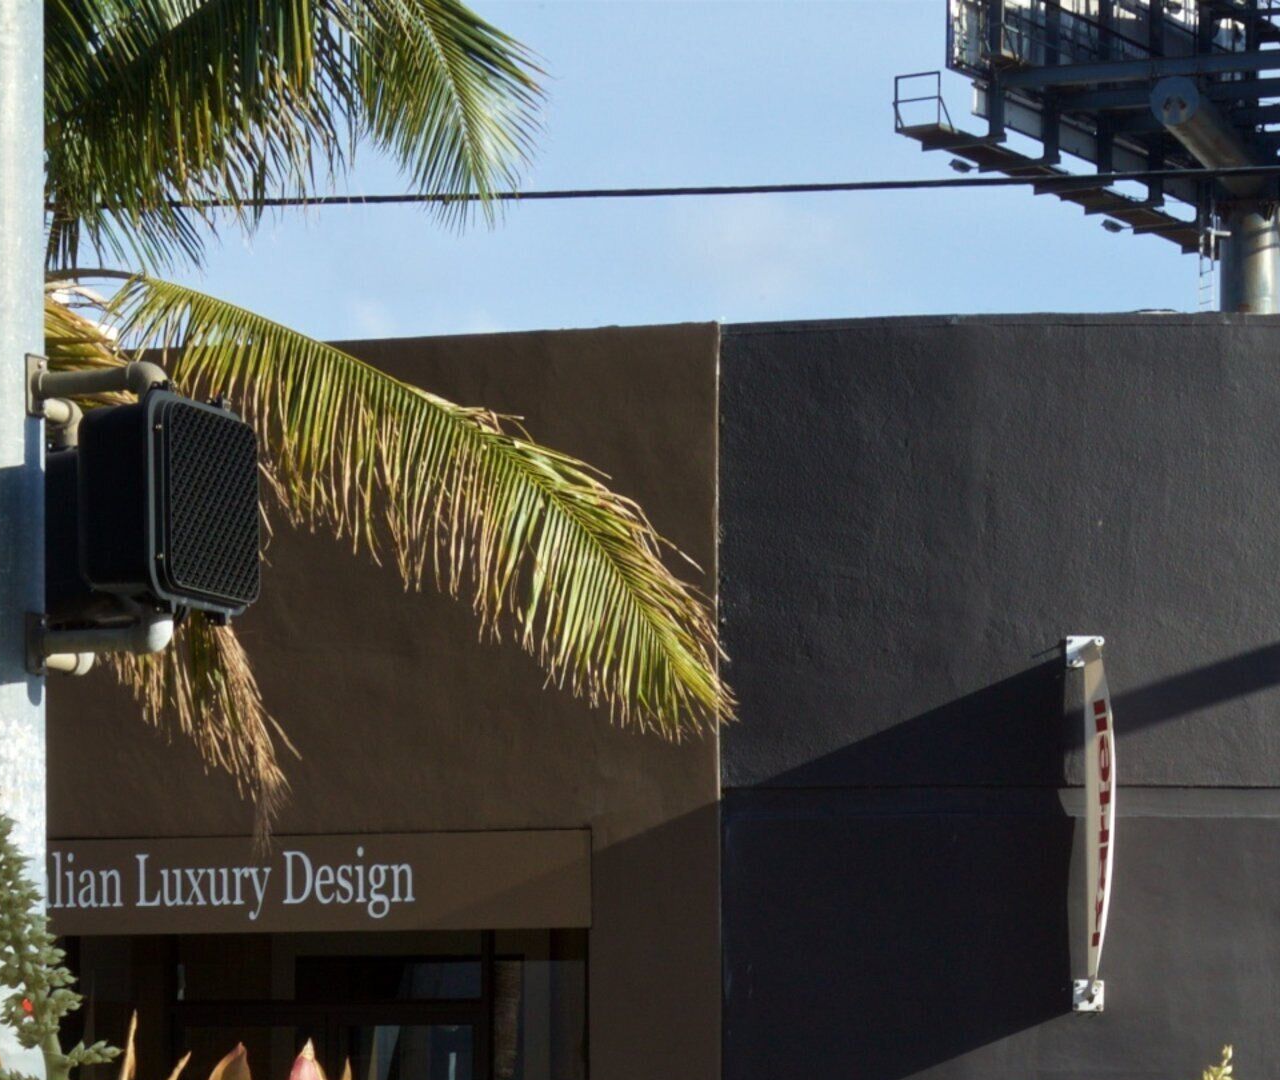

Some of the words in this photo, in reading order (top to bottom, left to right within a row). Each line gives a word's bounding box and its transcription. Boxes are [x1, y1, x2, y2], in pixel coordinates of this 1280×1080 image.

[45, 851, 123, 908] lian
[135, 853, 272, 920] Luxury
[282, 846, 416, 919] Design
